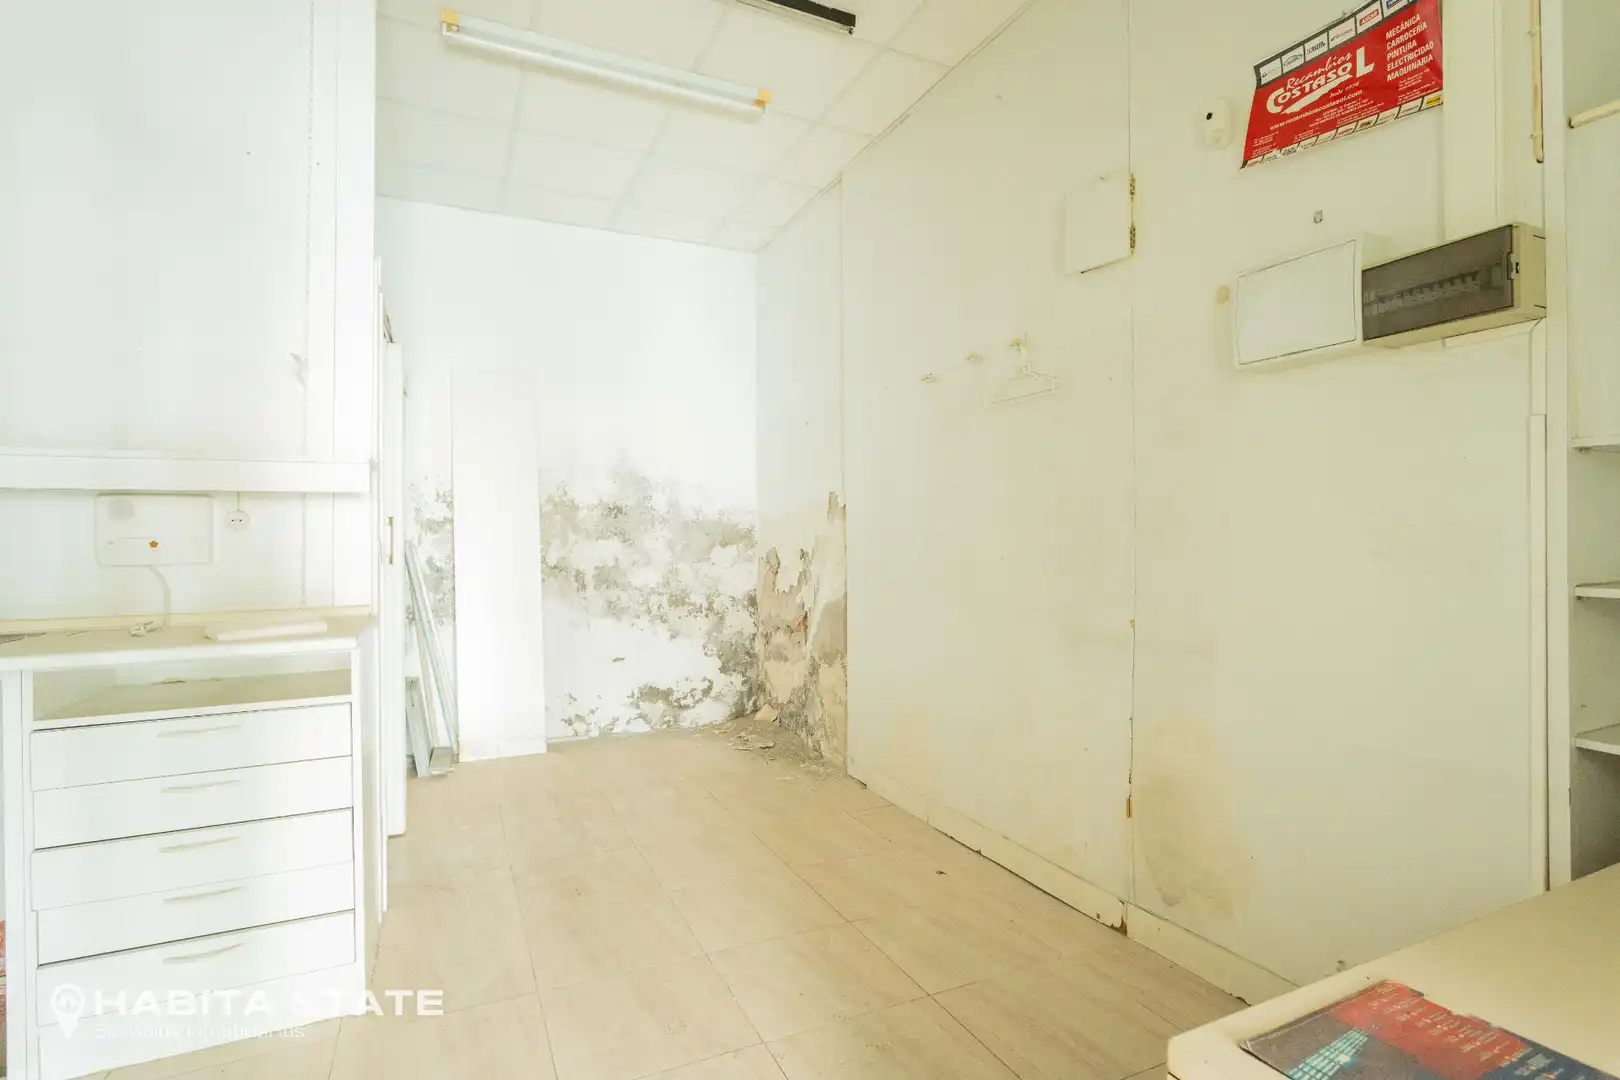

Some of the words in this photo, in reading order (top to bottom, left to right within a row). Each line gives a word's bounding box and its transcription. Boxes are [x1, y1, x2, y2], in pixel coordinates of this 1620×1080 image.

[1385, 13, 1421, 40] MECÁNICA
[1386, 20, 1428, 50] CARROCERÍA
[1387, 39, 1417, 61] PINTURA
[1387, 40, 1434, 72] ELECTRICIDAD
[1286, 52, 1353, 90] Recambios
[1387, 54, 1434, 82] MAQUINARIA
